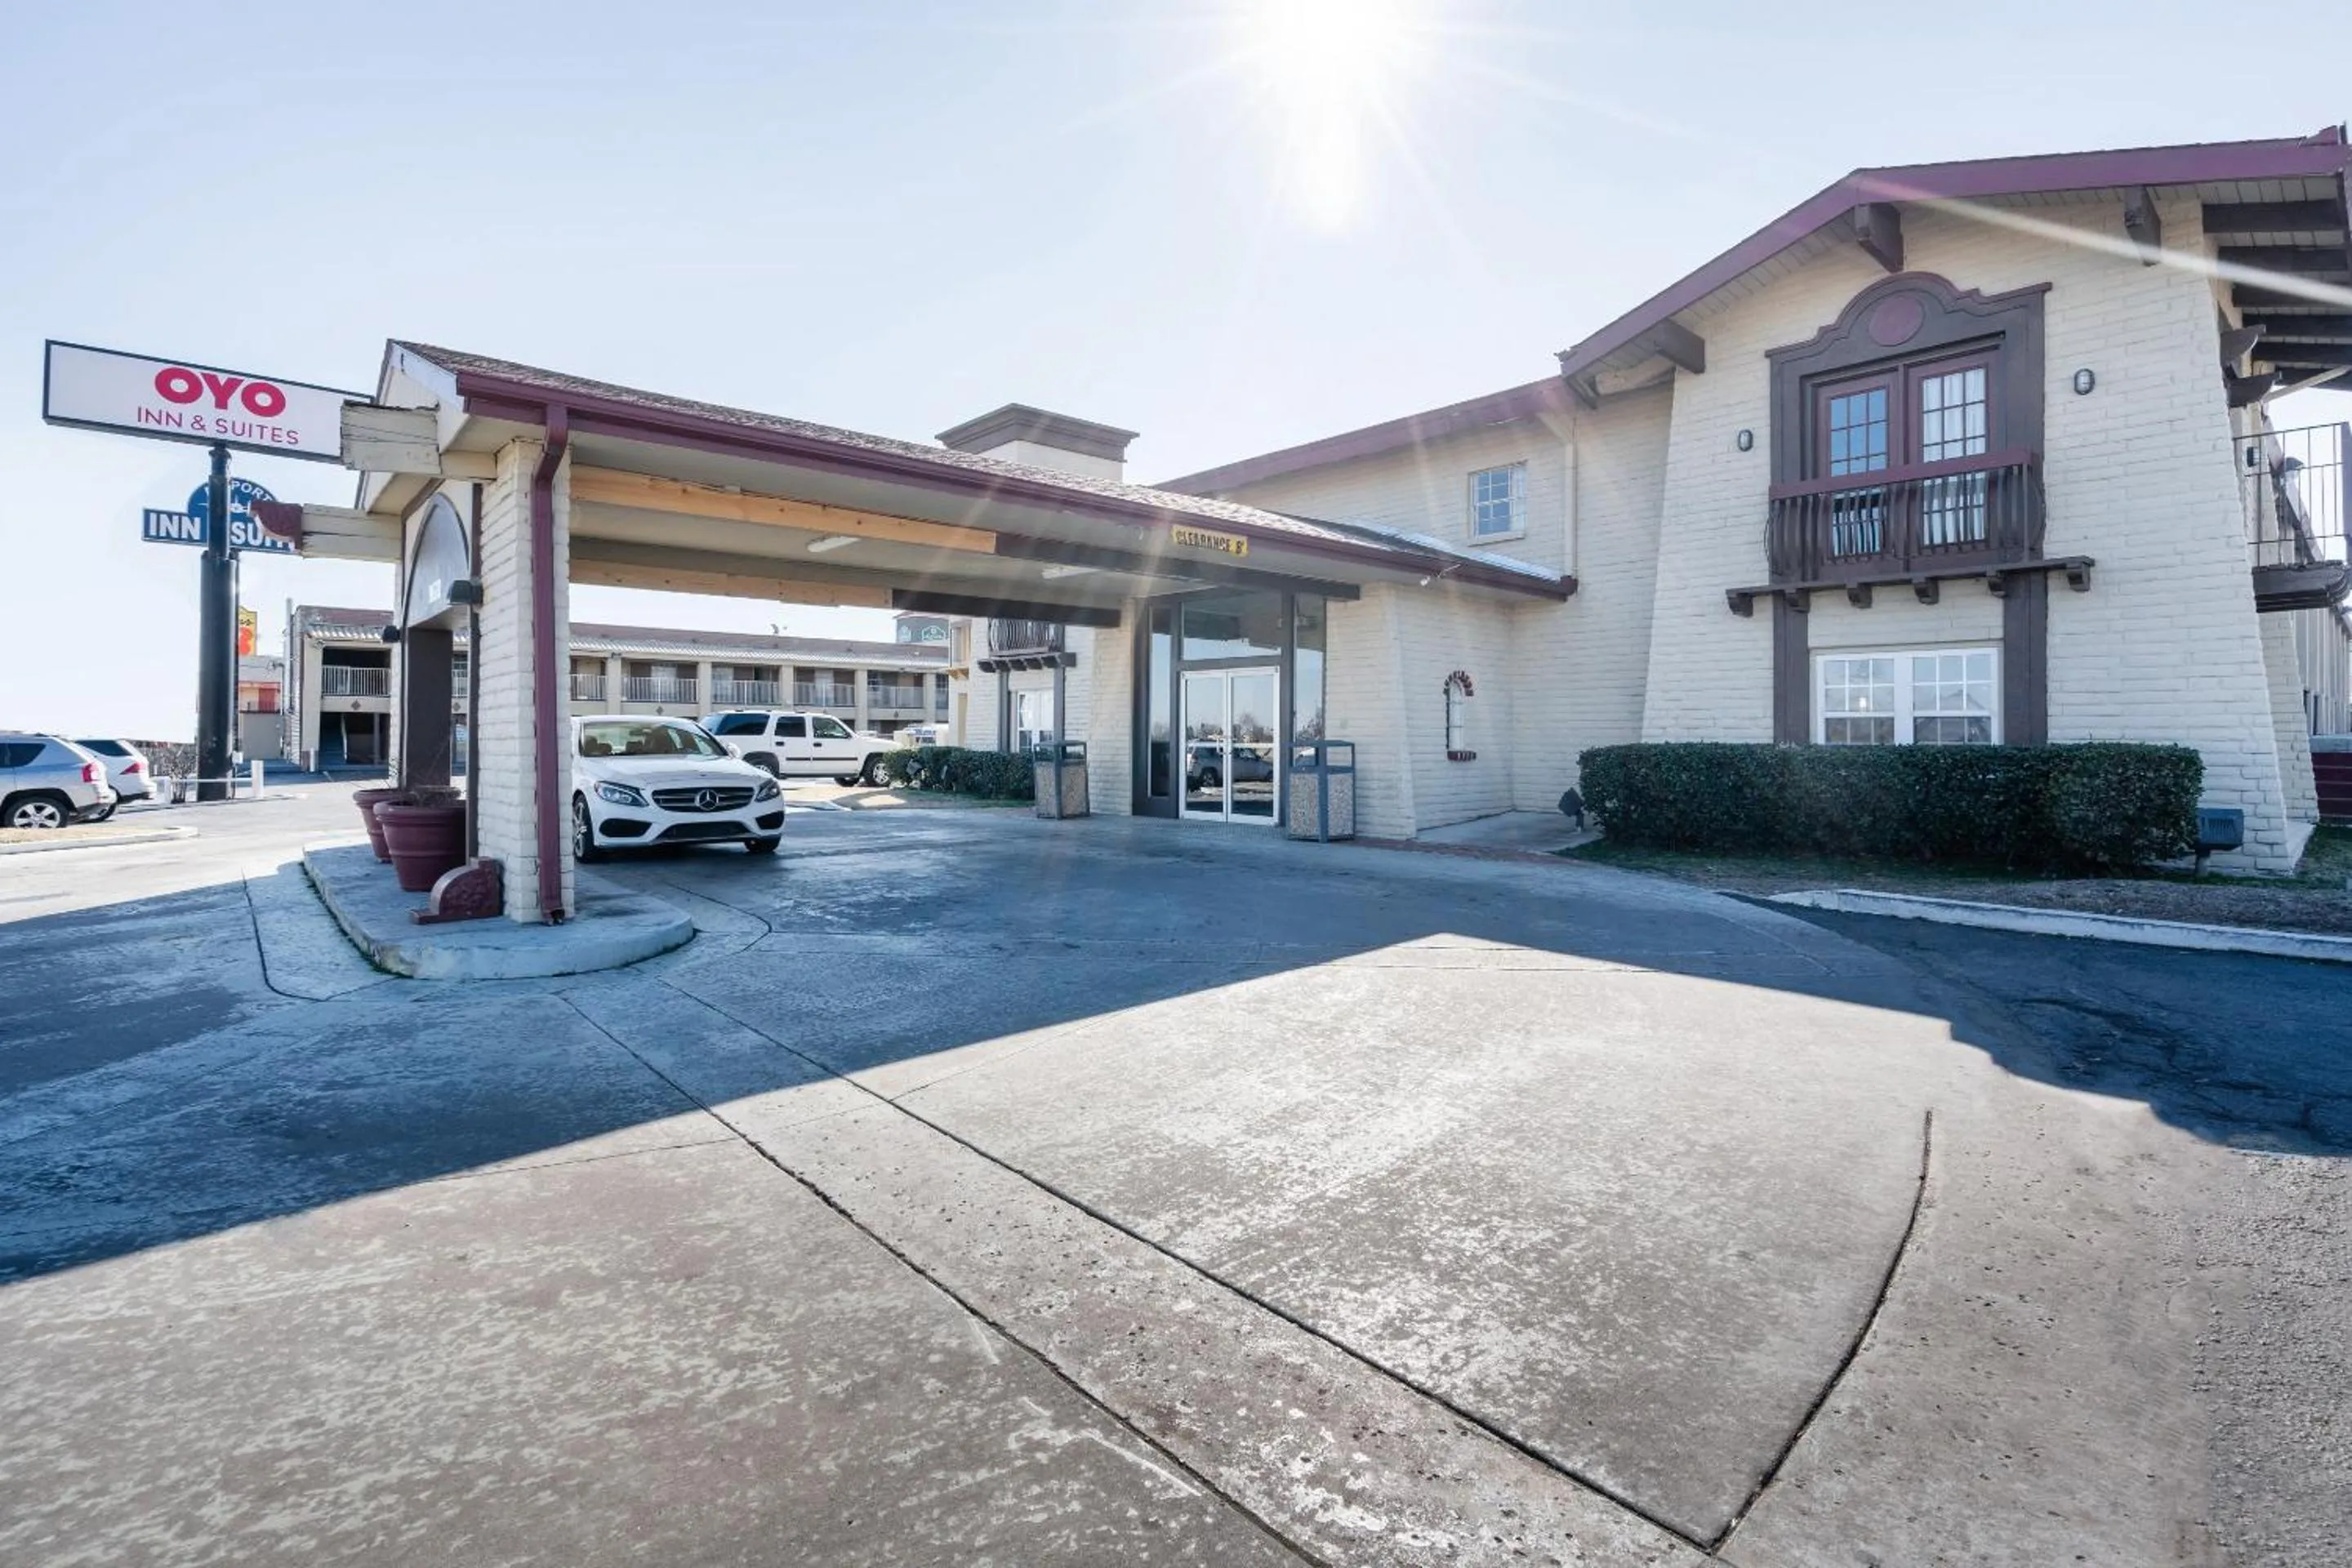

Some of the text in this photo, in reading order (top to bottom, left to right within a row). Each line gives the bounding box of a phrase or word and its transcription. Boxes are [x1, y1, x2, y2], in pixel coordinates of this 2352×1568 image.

[154, 367, 287, 417] OYO
[137, 406, 300, 445] INN & SUITES
[149, 512, 201, 541] INN
[1176, 530, 1231, 553] CLEARANCE
